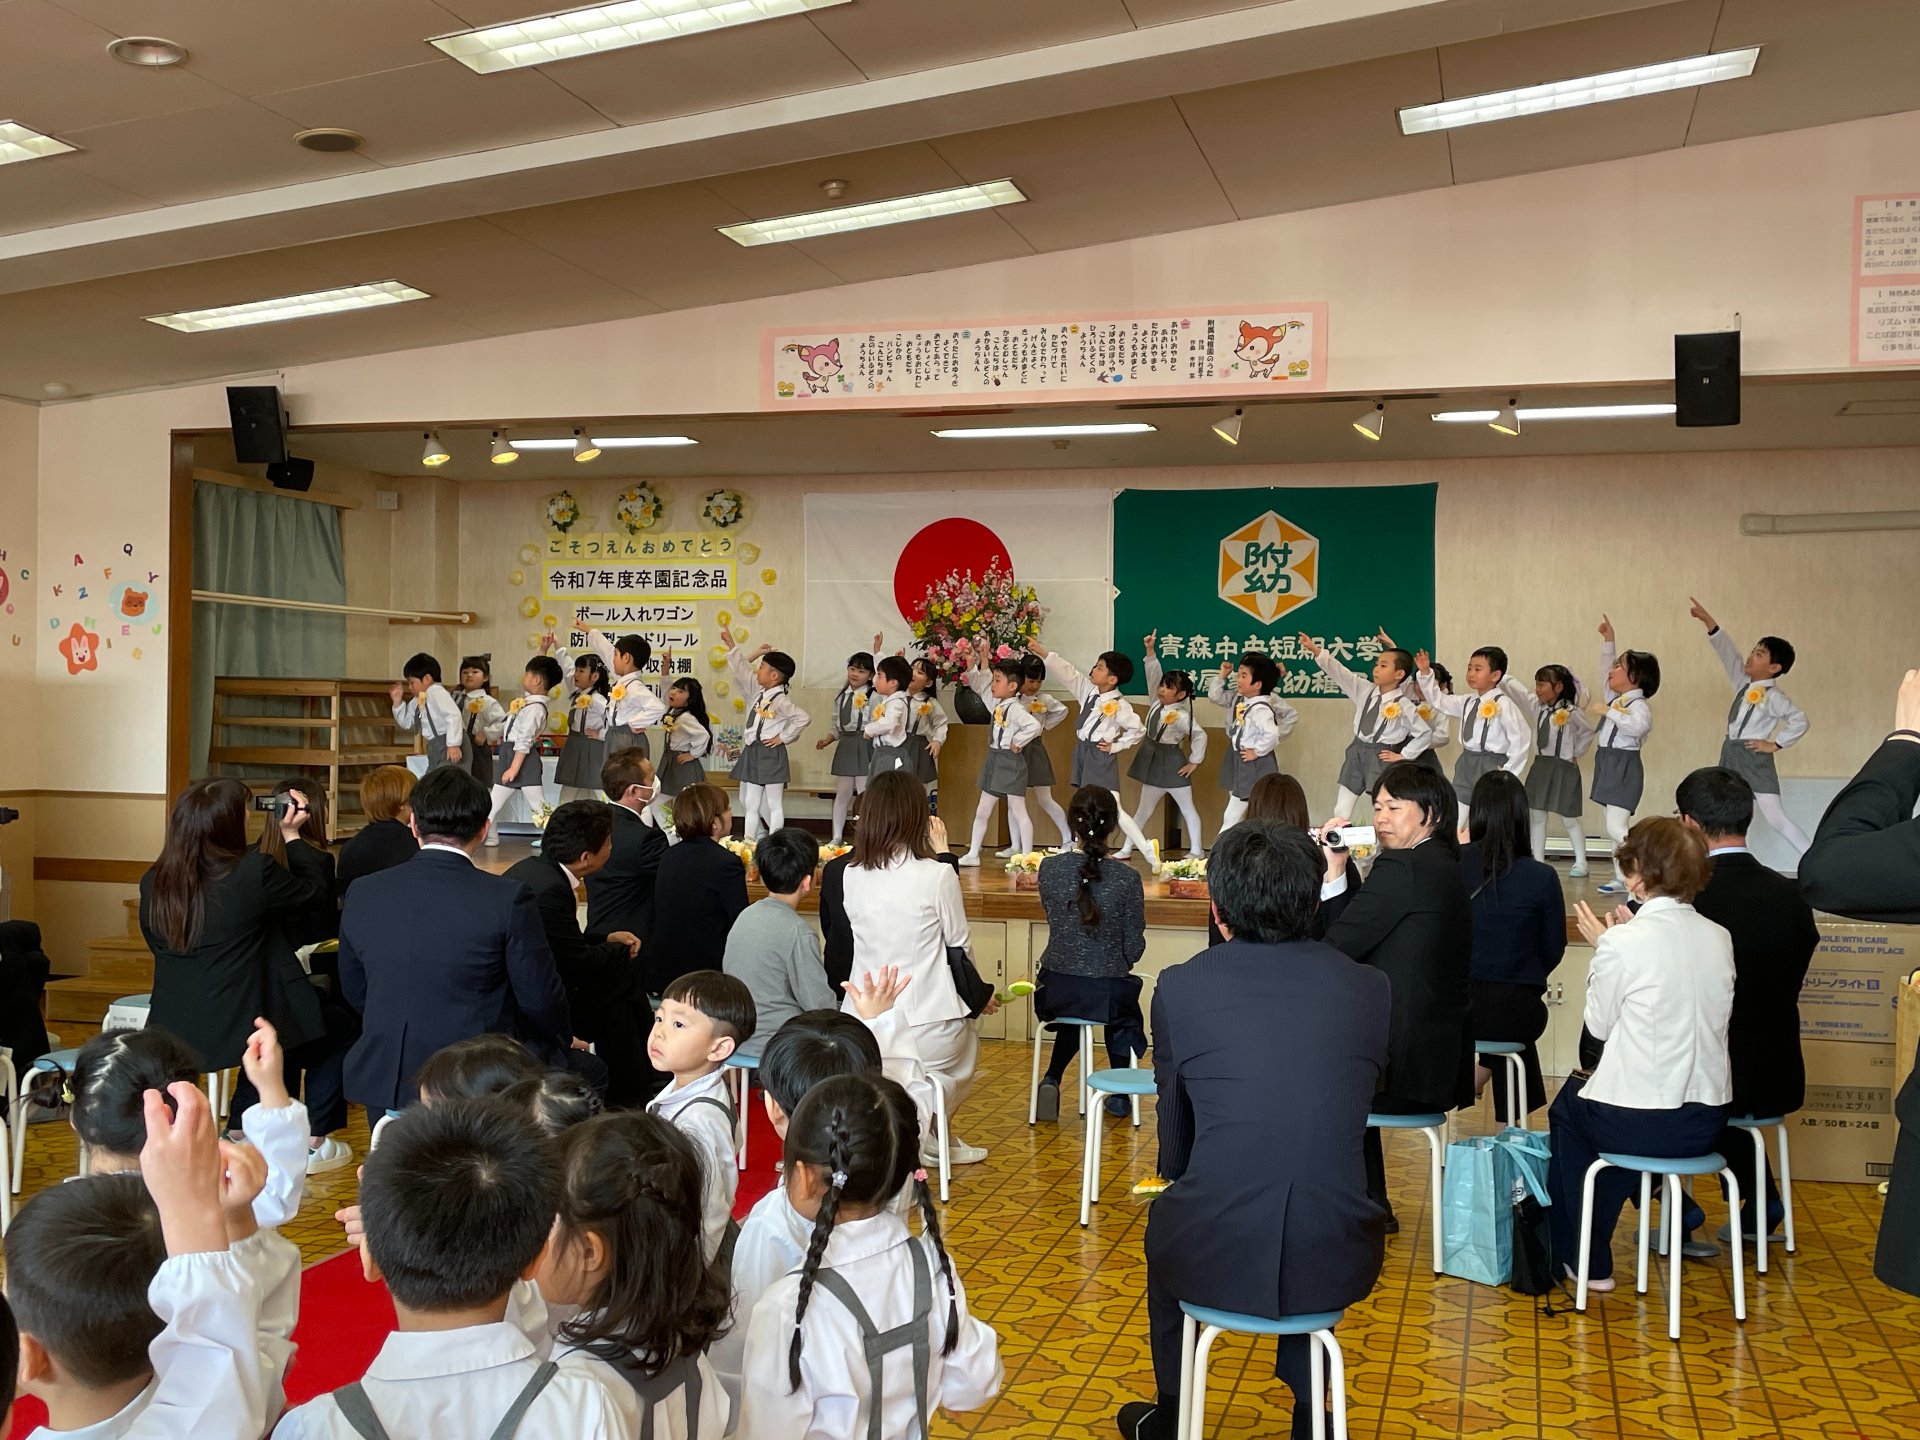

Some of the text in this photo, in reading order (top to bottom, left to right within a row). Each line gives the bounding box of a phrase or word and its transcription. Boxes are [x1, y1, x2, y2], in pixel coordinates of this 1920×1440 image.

[1011, 336, 1019, 370] おともだち
[1150, 322, 1158, 372] たかいおやまも
[124, 544, 134, 556] Q
[74, 554, 84, 566] A
[20, 569, 30, 580] C
[104, 568, 112, 580] F
[148, 572, 160, 584] Y
[549, 568, 728, 590] 令和7年度卒園記念品
[52, 584, 62, 596] K
[78, 587, 88, 600] Z
[575, 606, 694, 622] ボール入れワゴン
[50, 618, 60, 630] D
[121, 624, 130, 636] E
[12, 634, 21, 646] U
[570, 631, 699, 648] 防型ドリール
[1158, 633, 1386, 662] 青森中央短期大学
[1877, 947, 1905, 956] PLACE
[1836, 1090, 1886, 1101] EVERY
